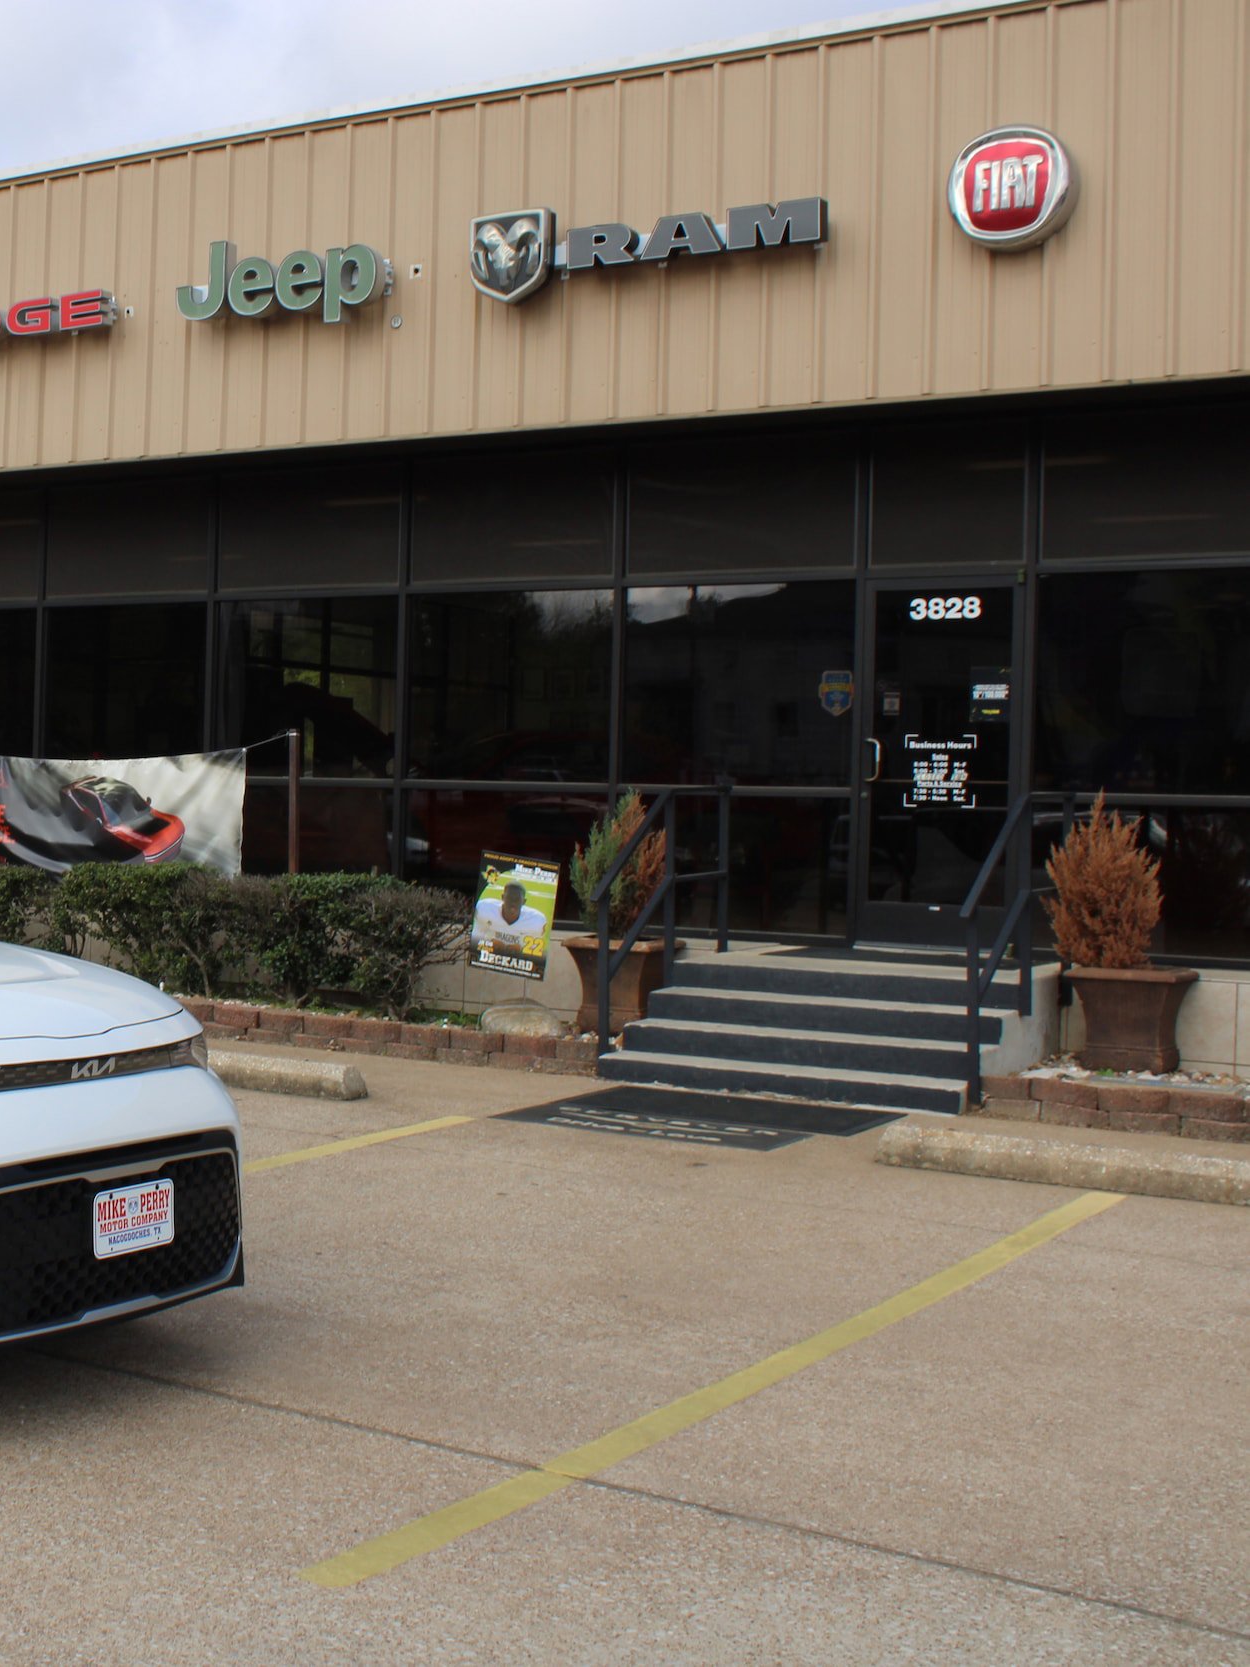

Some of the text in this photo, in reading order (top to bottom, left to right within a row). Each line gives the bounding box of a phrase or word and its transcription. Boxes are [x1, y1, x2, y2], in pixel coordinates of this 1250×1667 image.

[972, 153, 1045, 213] FIAT
[565, 196, 826, 271] RAM
[175, 239, 380, 324] Jeep
[909, 595, 982, 621] 3828
[909, 740, 972, 749] Business Hours
[522, 935, 544, 957] 22
[479, 950, 534, 972] DECKARD
[97, 1188, 171, 1222] MIKE PERRY
[99, 1209, 169, 1234] MOTOR COMPANY
[153, 1226, 162, 1236] TX
